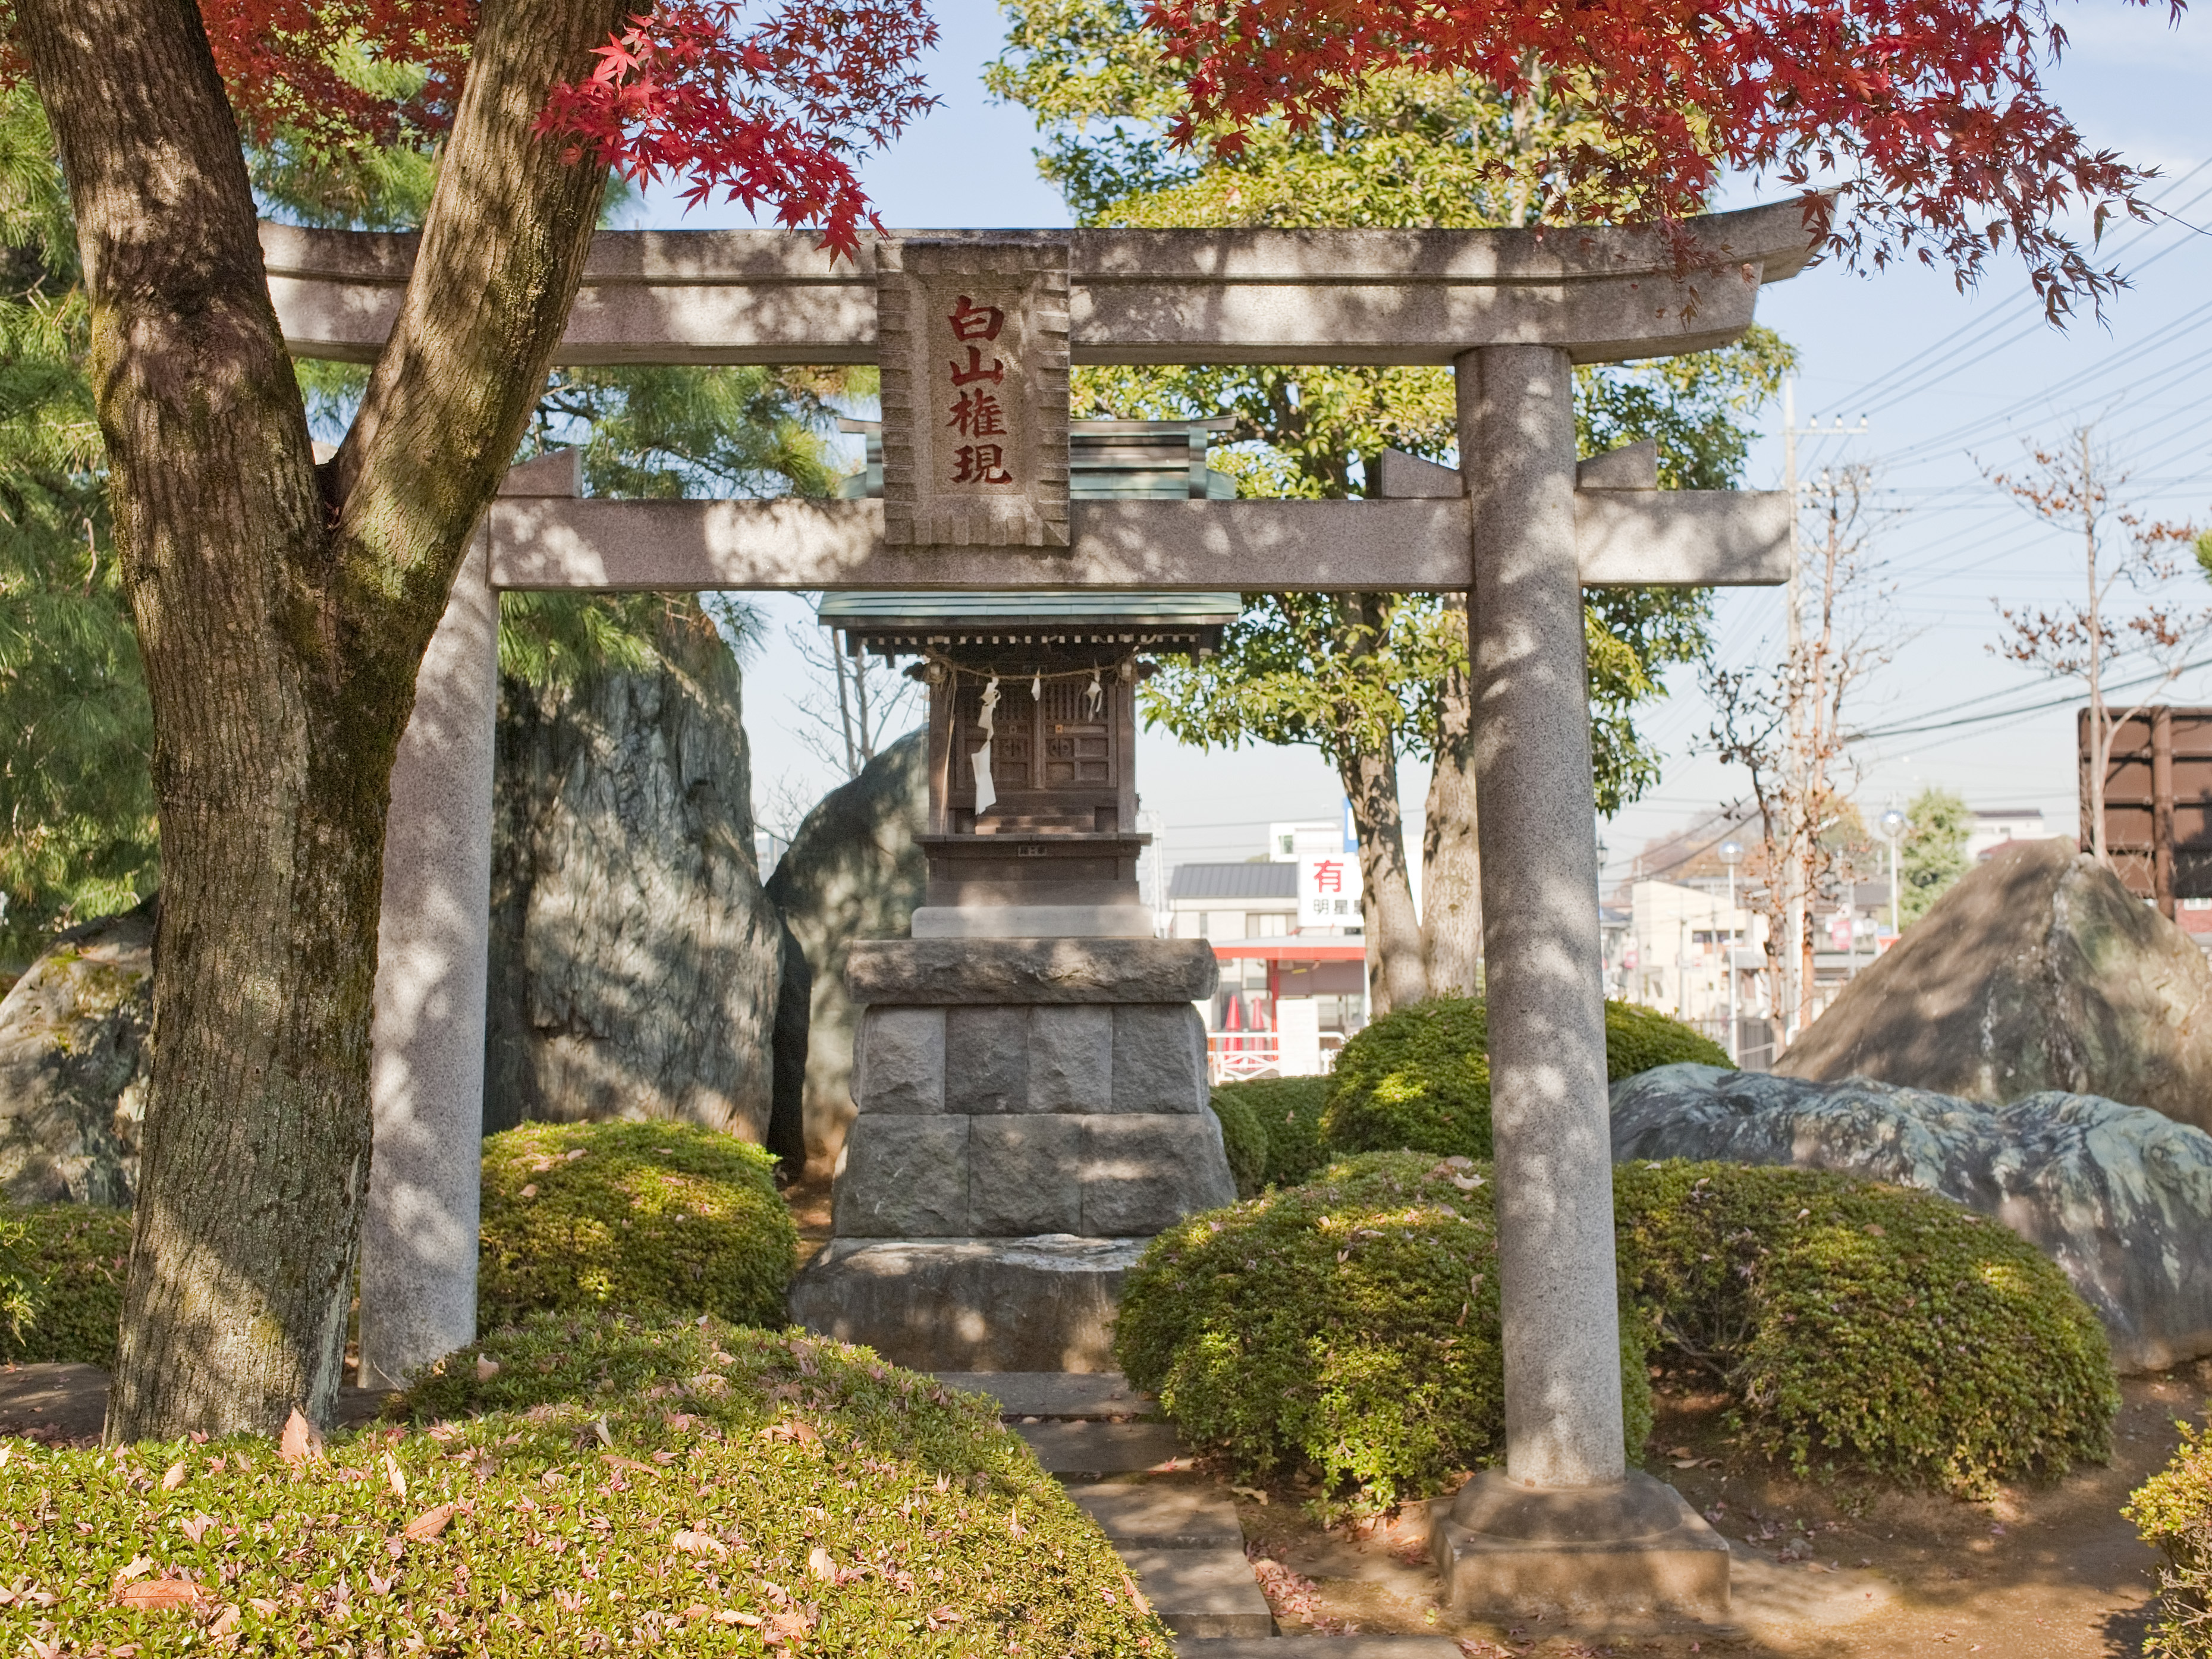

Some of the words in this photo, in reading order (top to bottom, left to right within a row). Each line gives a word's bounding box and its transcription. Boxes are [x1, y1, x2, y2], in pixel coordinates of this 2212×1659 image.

[945, 295, 1013, 485] 白山権現
[1314, 860, 1344, 893] 有
